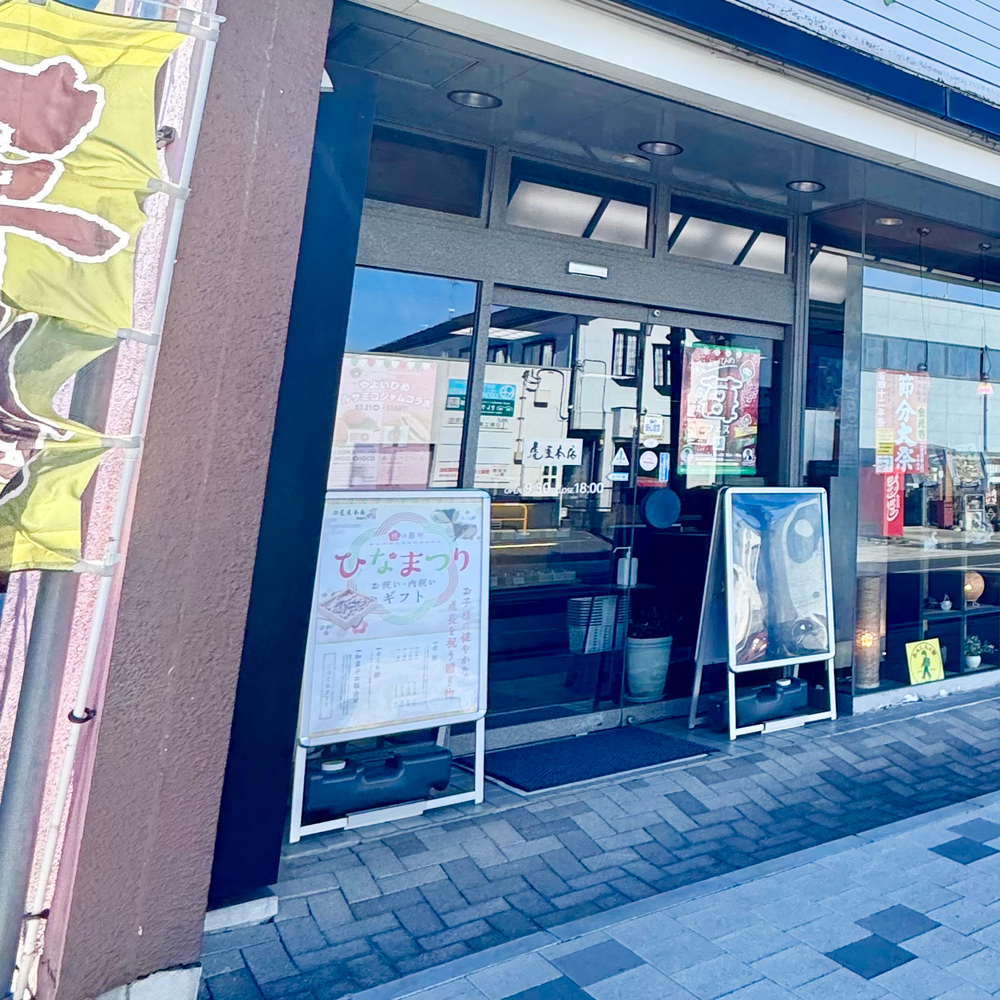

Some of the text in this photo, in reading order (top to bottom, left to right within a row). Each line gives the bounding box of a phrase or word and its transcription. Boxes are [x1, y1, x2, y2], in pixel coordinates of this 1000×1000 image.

[359, 380, 411, 392] やよいひめ
[895, 373, 917, 472] 節分大祭
[527, 441, 577, 460] 虎屋本店
[504, 487, 522, 495] OPEN
[574, 482, 604, 494] 18:00
[334, 547, 469, 578] ひなまつり
[383, 590, 424, 604] ギフト
